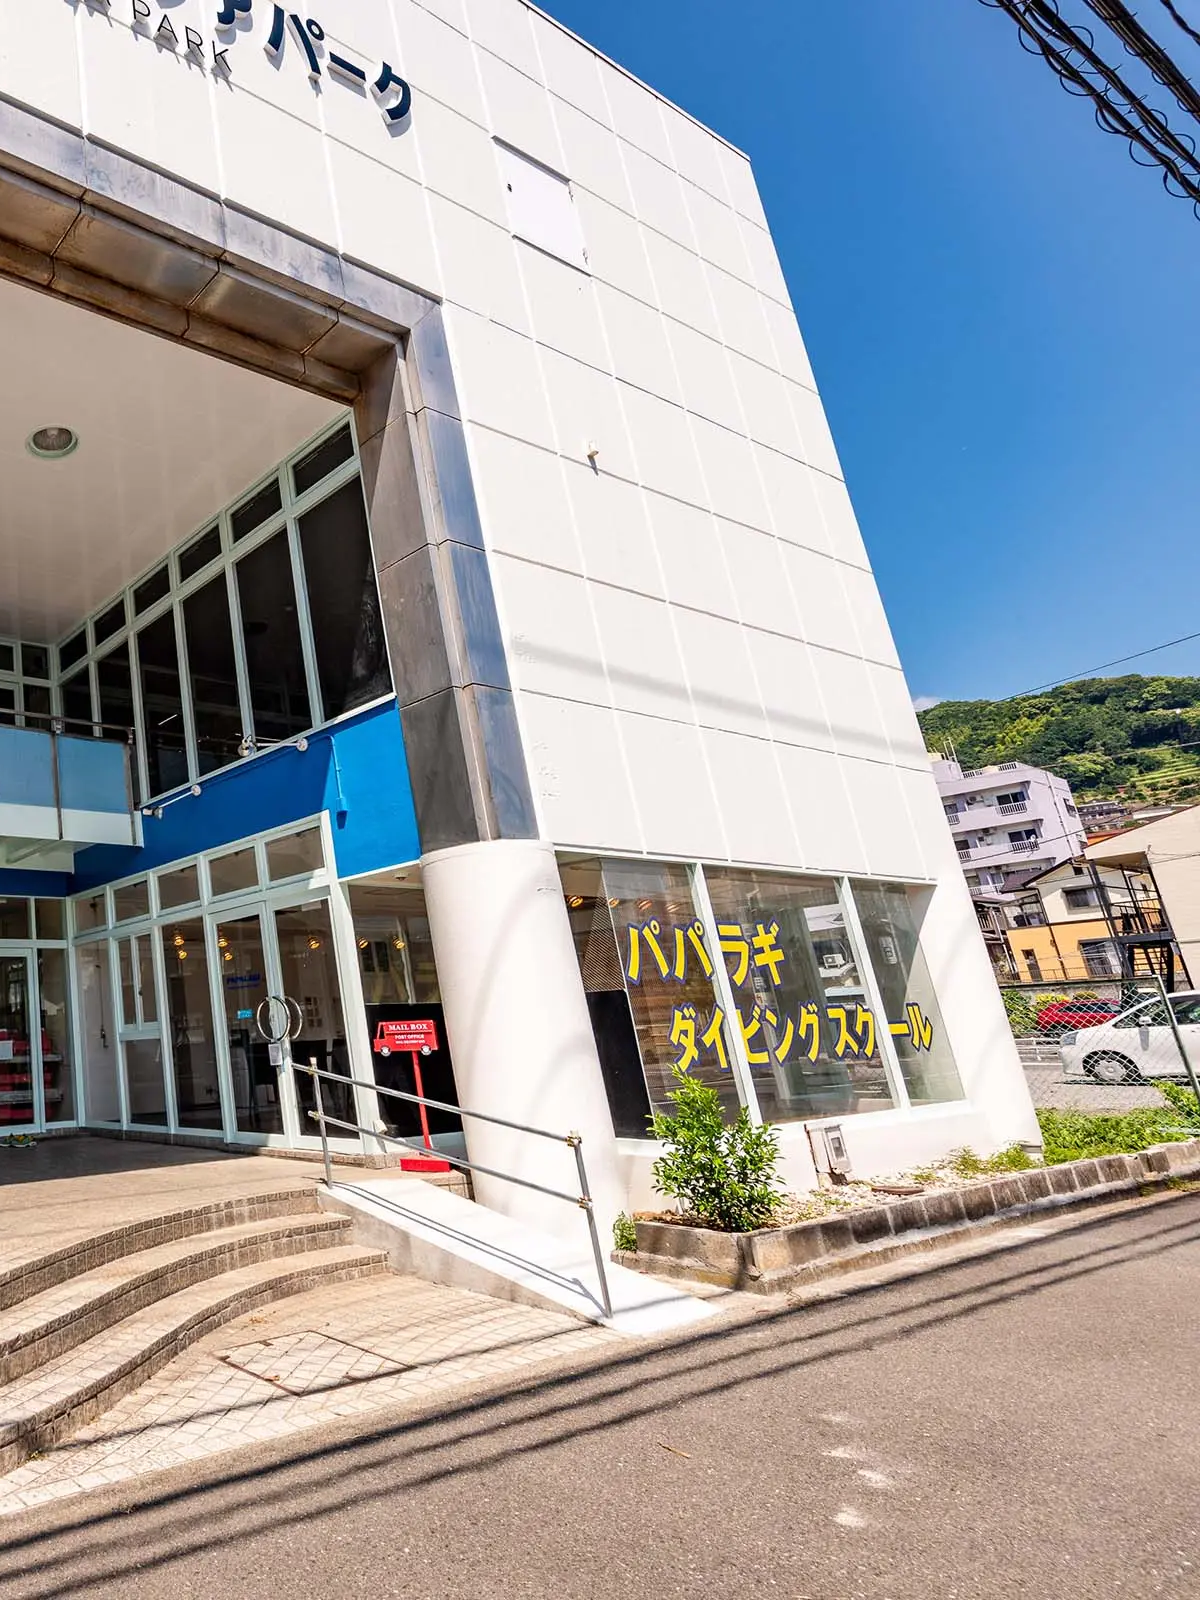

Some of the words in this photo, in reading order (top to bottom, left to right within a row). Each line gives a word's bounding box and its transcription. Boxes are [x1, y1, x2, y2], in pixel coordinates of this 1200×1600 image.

[132, 0, 231, 72] PARK
[625, 916, 786, 988] パパラギ
[668, 1000, 933, 1073] ダイビングスクール
